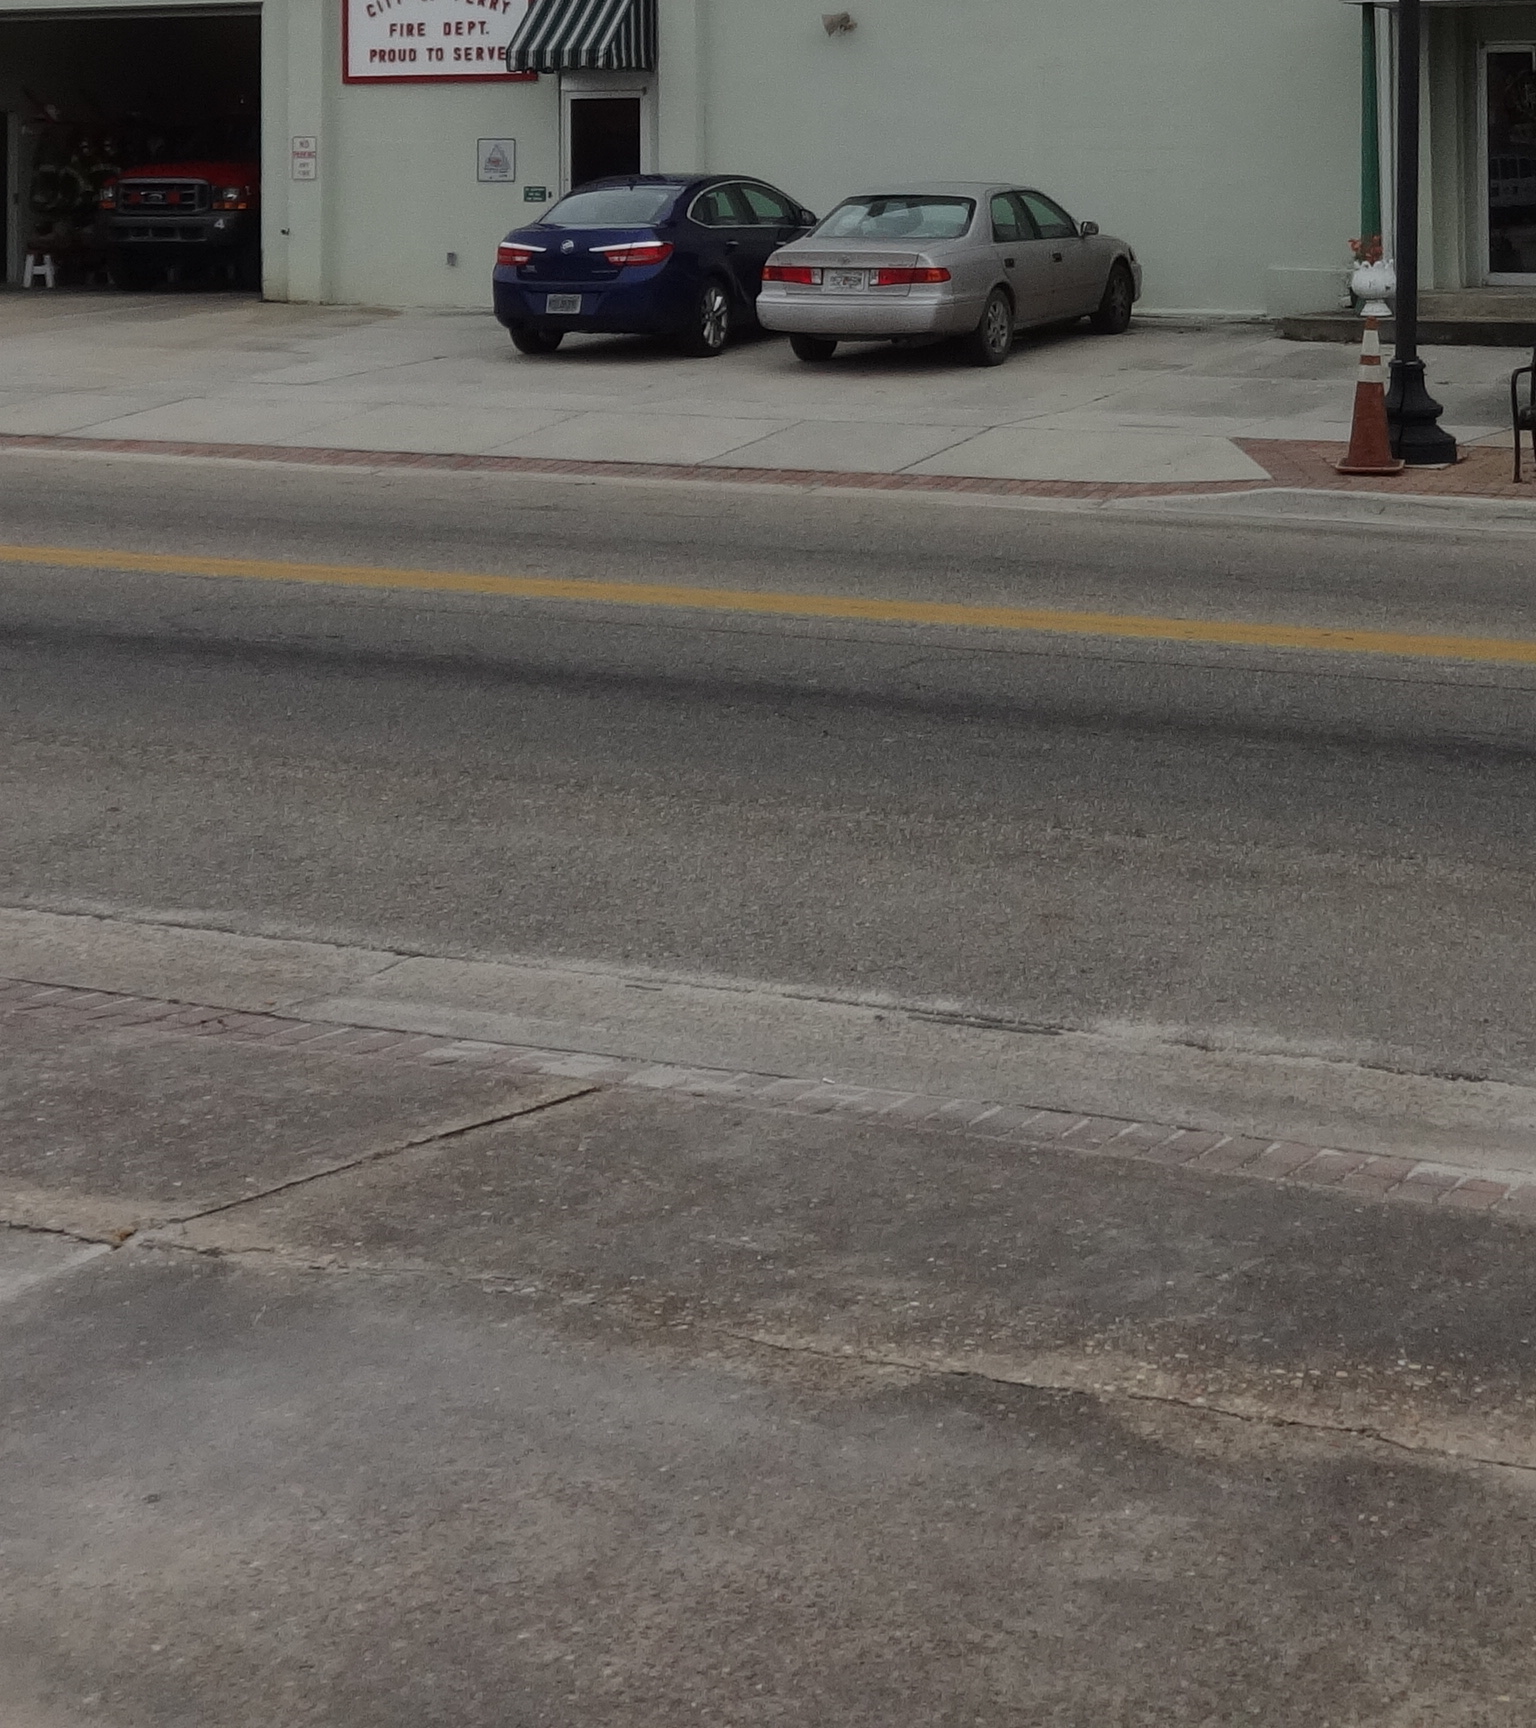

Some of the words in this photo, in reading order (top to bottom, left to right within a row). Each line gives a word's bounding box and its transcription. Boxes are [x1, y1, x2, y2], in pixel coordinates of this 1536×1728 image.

[389, 23, 426, 37] FIRE
[443, 21, 490, 36] DEPT.
[369, 49, 417, 63] PROUD
[426, 48, 444, 61] TO
[453, 46, 506, 61] SERVE
